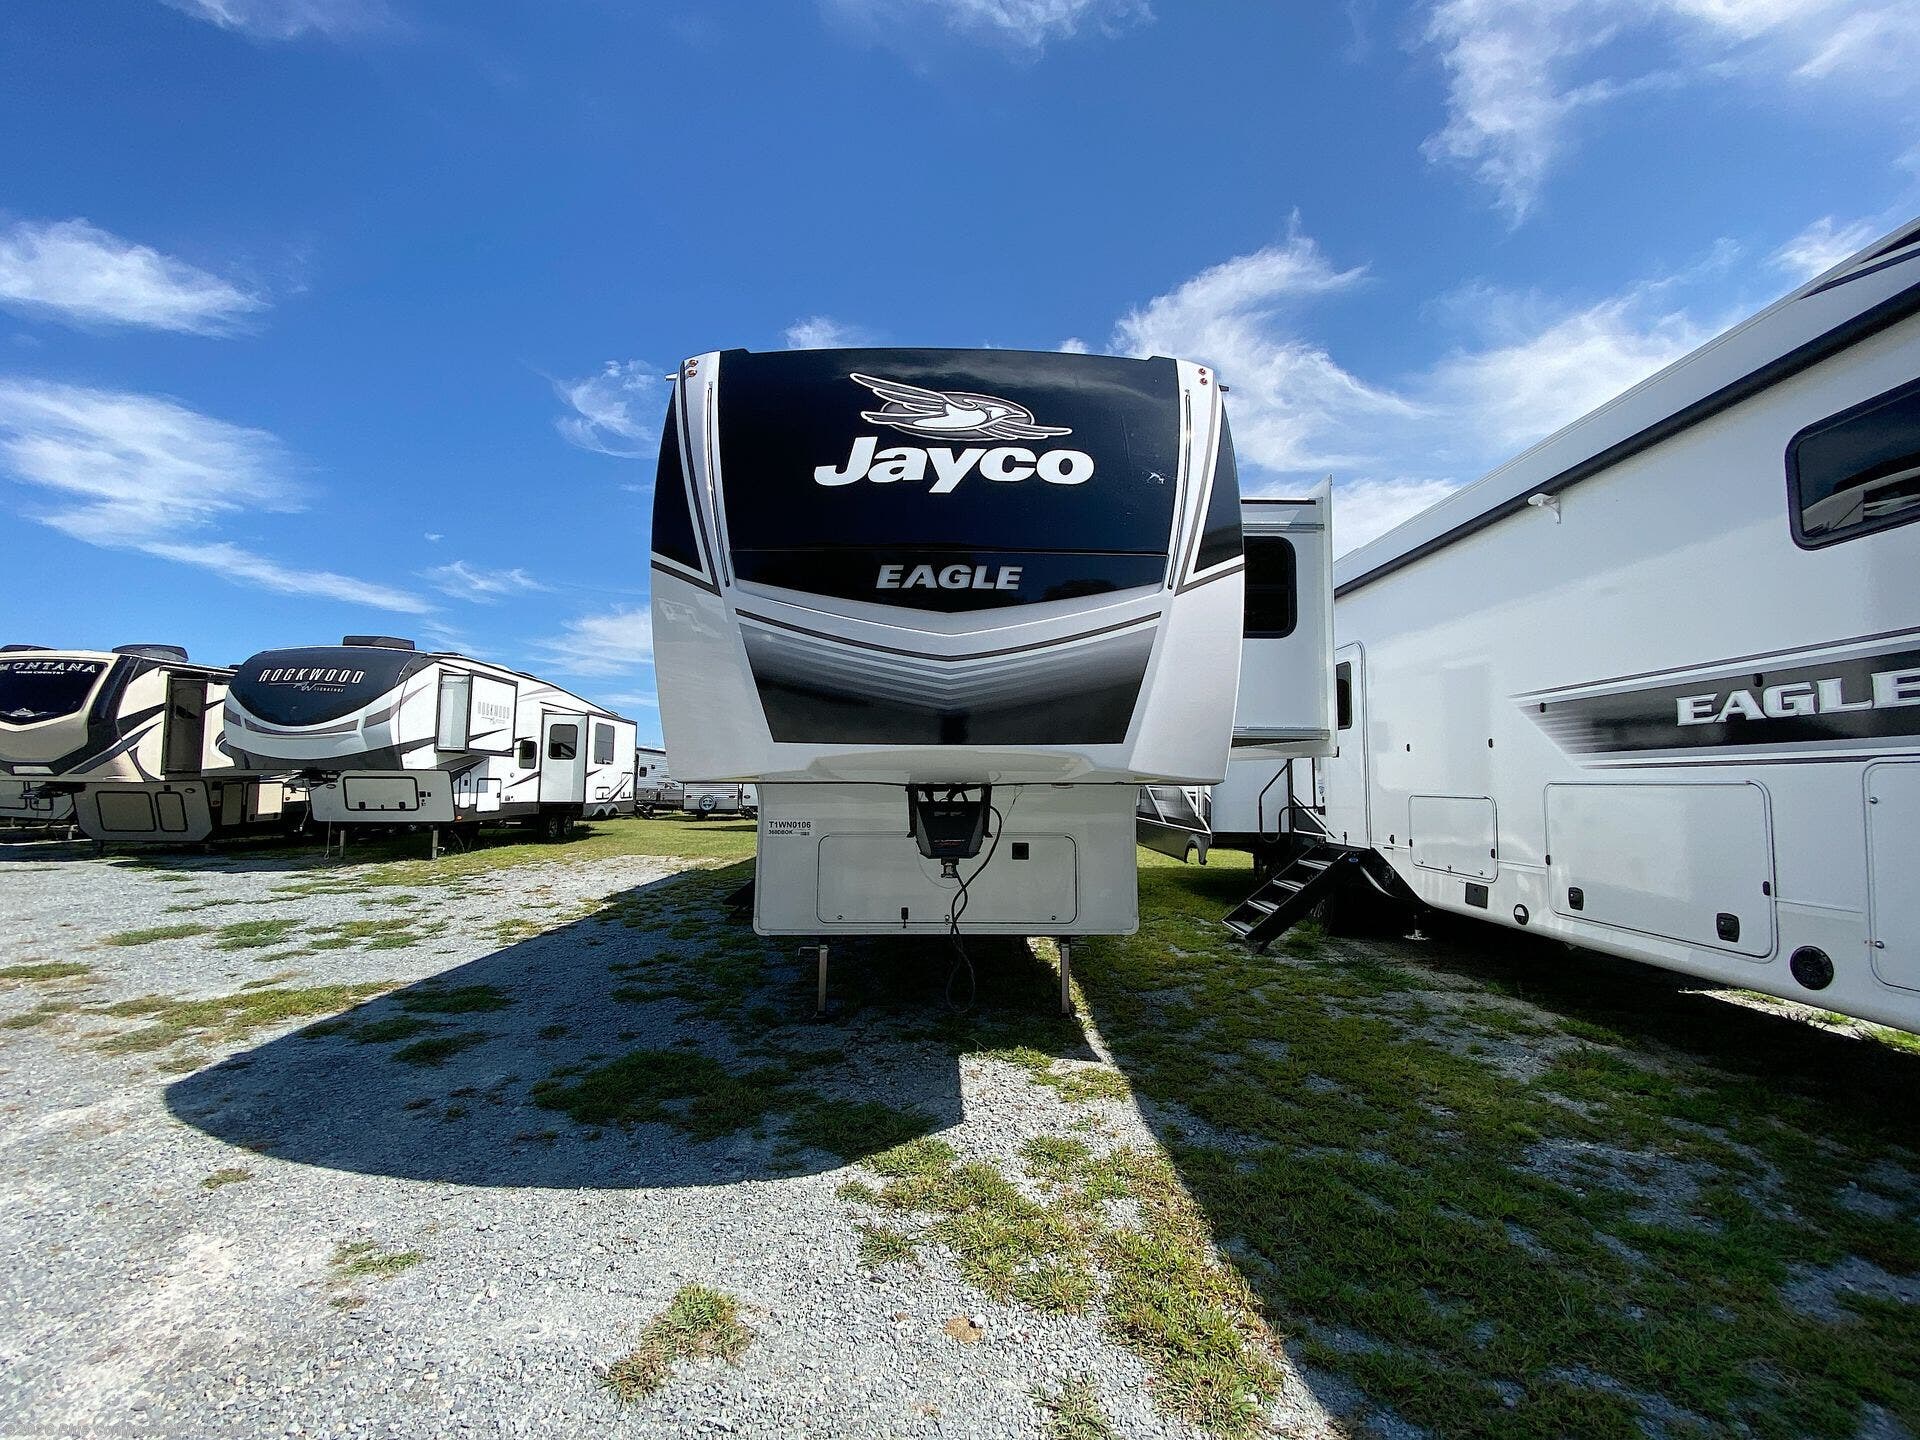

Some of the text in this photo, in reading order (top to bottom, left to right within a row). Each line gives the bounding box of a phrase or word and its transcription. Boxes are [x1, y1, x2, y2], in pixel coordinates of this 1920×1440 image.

[813, 436, 1095, 493] Jayco
[875, 564, 1023, 590] EAGLE
[258, 668, 365, 684] ROCKWOOD
[1676, 667, 1920, 727] EAGLE
